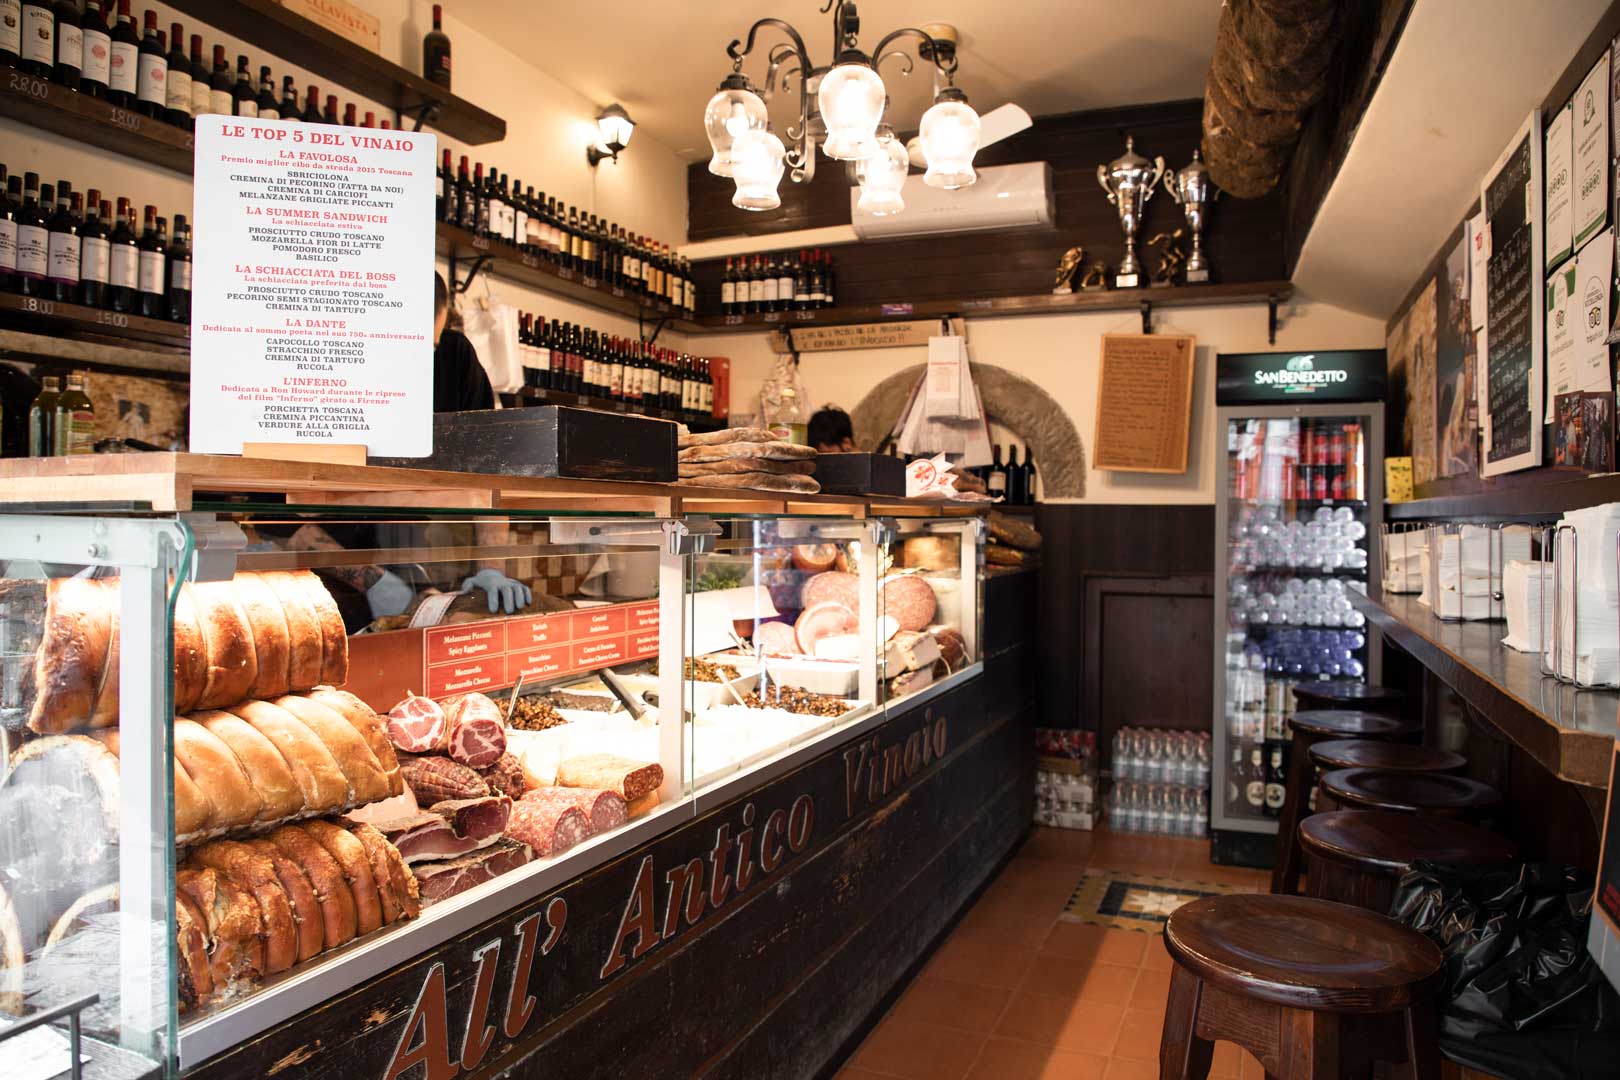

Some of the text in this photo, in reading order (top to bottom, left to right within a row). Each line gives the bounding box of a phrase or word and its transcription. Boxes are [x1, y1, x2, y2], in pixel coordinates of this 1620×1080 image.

[10, 73, 48, 98] 28.00
[221, 124, 414, 152] LE TOP 5 DEL VINAIO
[279, 150, 358, 164] LA FAVOLOSA
[221, 154, 253, 164] Premio
[256, 158, 289, 166] miglior
[325, 164, 354, 172] strada
[378, 167, 413, 176] Toscana
[287, 171, 349, 182] SBRICIOLONA
[230, 174, 274, 184] CREMINA
[289, 179, 336, 188] PECORINO
[337, 182, 368, 191] (FATTA
[384, 186, 404, 194] NOI)
[267, 185, 310, 195] CREMINA
[325, 189, 368, 199] CARCIOFI
[239, 191, 394, 208] MELANZANE GRIGLIATE PICCANTI
[246, 206, 388, 224] LA SUMMER SANDWICH
[285, 219, 335, 228] schiacciata
[248, 227, 384, 242] PROSCIUTTO CRUDO TOSCANO
[251, 235, 314, 245] MOZZARELLA
[316, 239, 338, 247] FIOR
[352, 241, 381, 249] LATTE
[272, 244, 361, 256] POMODORO FRESCO
[296, 254, 338, 262] BASILICO
[235, 265, 396, 281] LA SCHIACCIATA DEL BOSS
[258, 276, 308, 284] schiacciata
[311, 279, 350, 287] preferita
[247, 286, 384, 299] PROSCIUTTO CRUDO TOSCANO
[227, 293, 403, 308] PECORINO SEMI STAGIONATO TOSCANO
[21, 299, 54, 315] 18.00
[265, 303, 308, 311] CREMINA
[324, 306, 366, 314] TARTUFO
[202, 324, 241, 332] Dedicata
[286, 318, 346, 329] LA DANTE
[266, 338, 364, 348] CAPOCOLLO TOSCANO
[266, 346, 364, 356] STRACCHINO FRESCO
[264, 354, 308, 362] CREMINA
[323, 356, 365, 364] TARTUFO
[296, 363, 333, 371] RUCOLA
[284, 377, 347, 387] L'INFERNO
[376, 390, 406, 398] riprese
[264, 405, 319, 413] PORCHETTA
[263, 413, 306, 421] CREMINA
[258, 421, 303, 429] VERDURE
[600, 793, 815, 980] Antico
[843, 707, 948, 818] Vinaio
